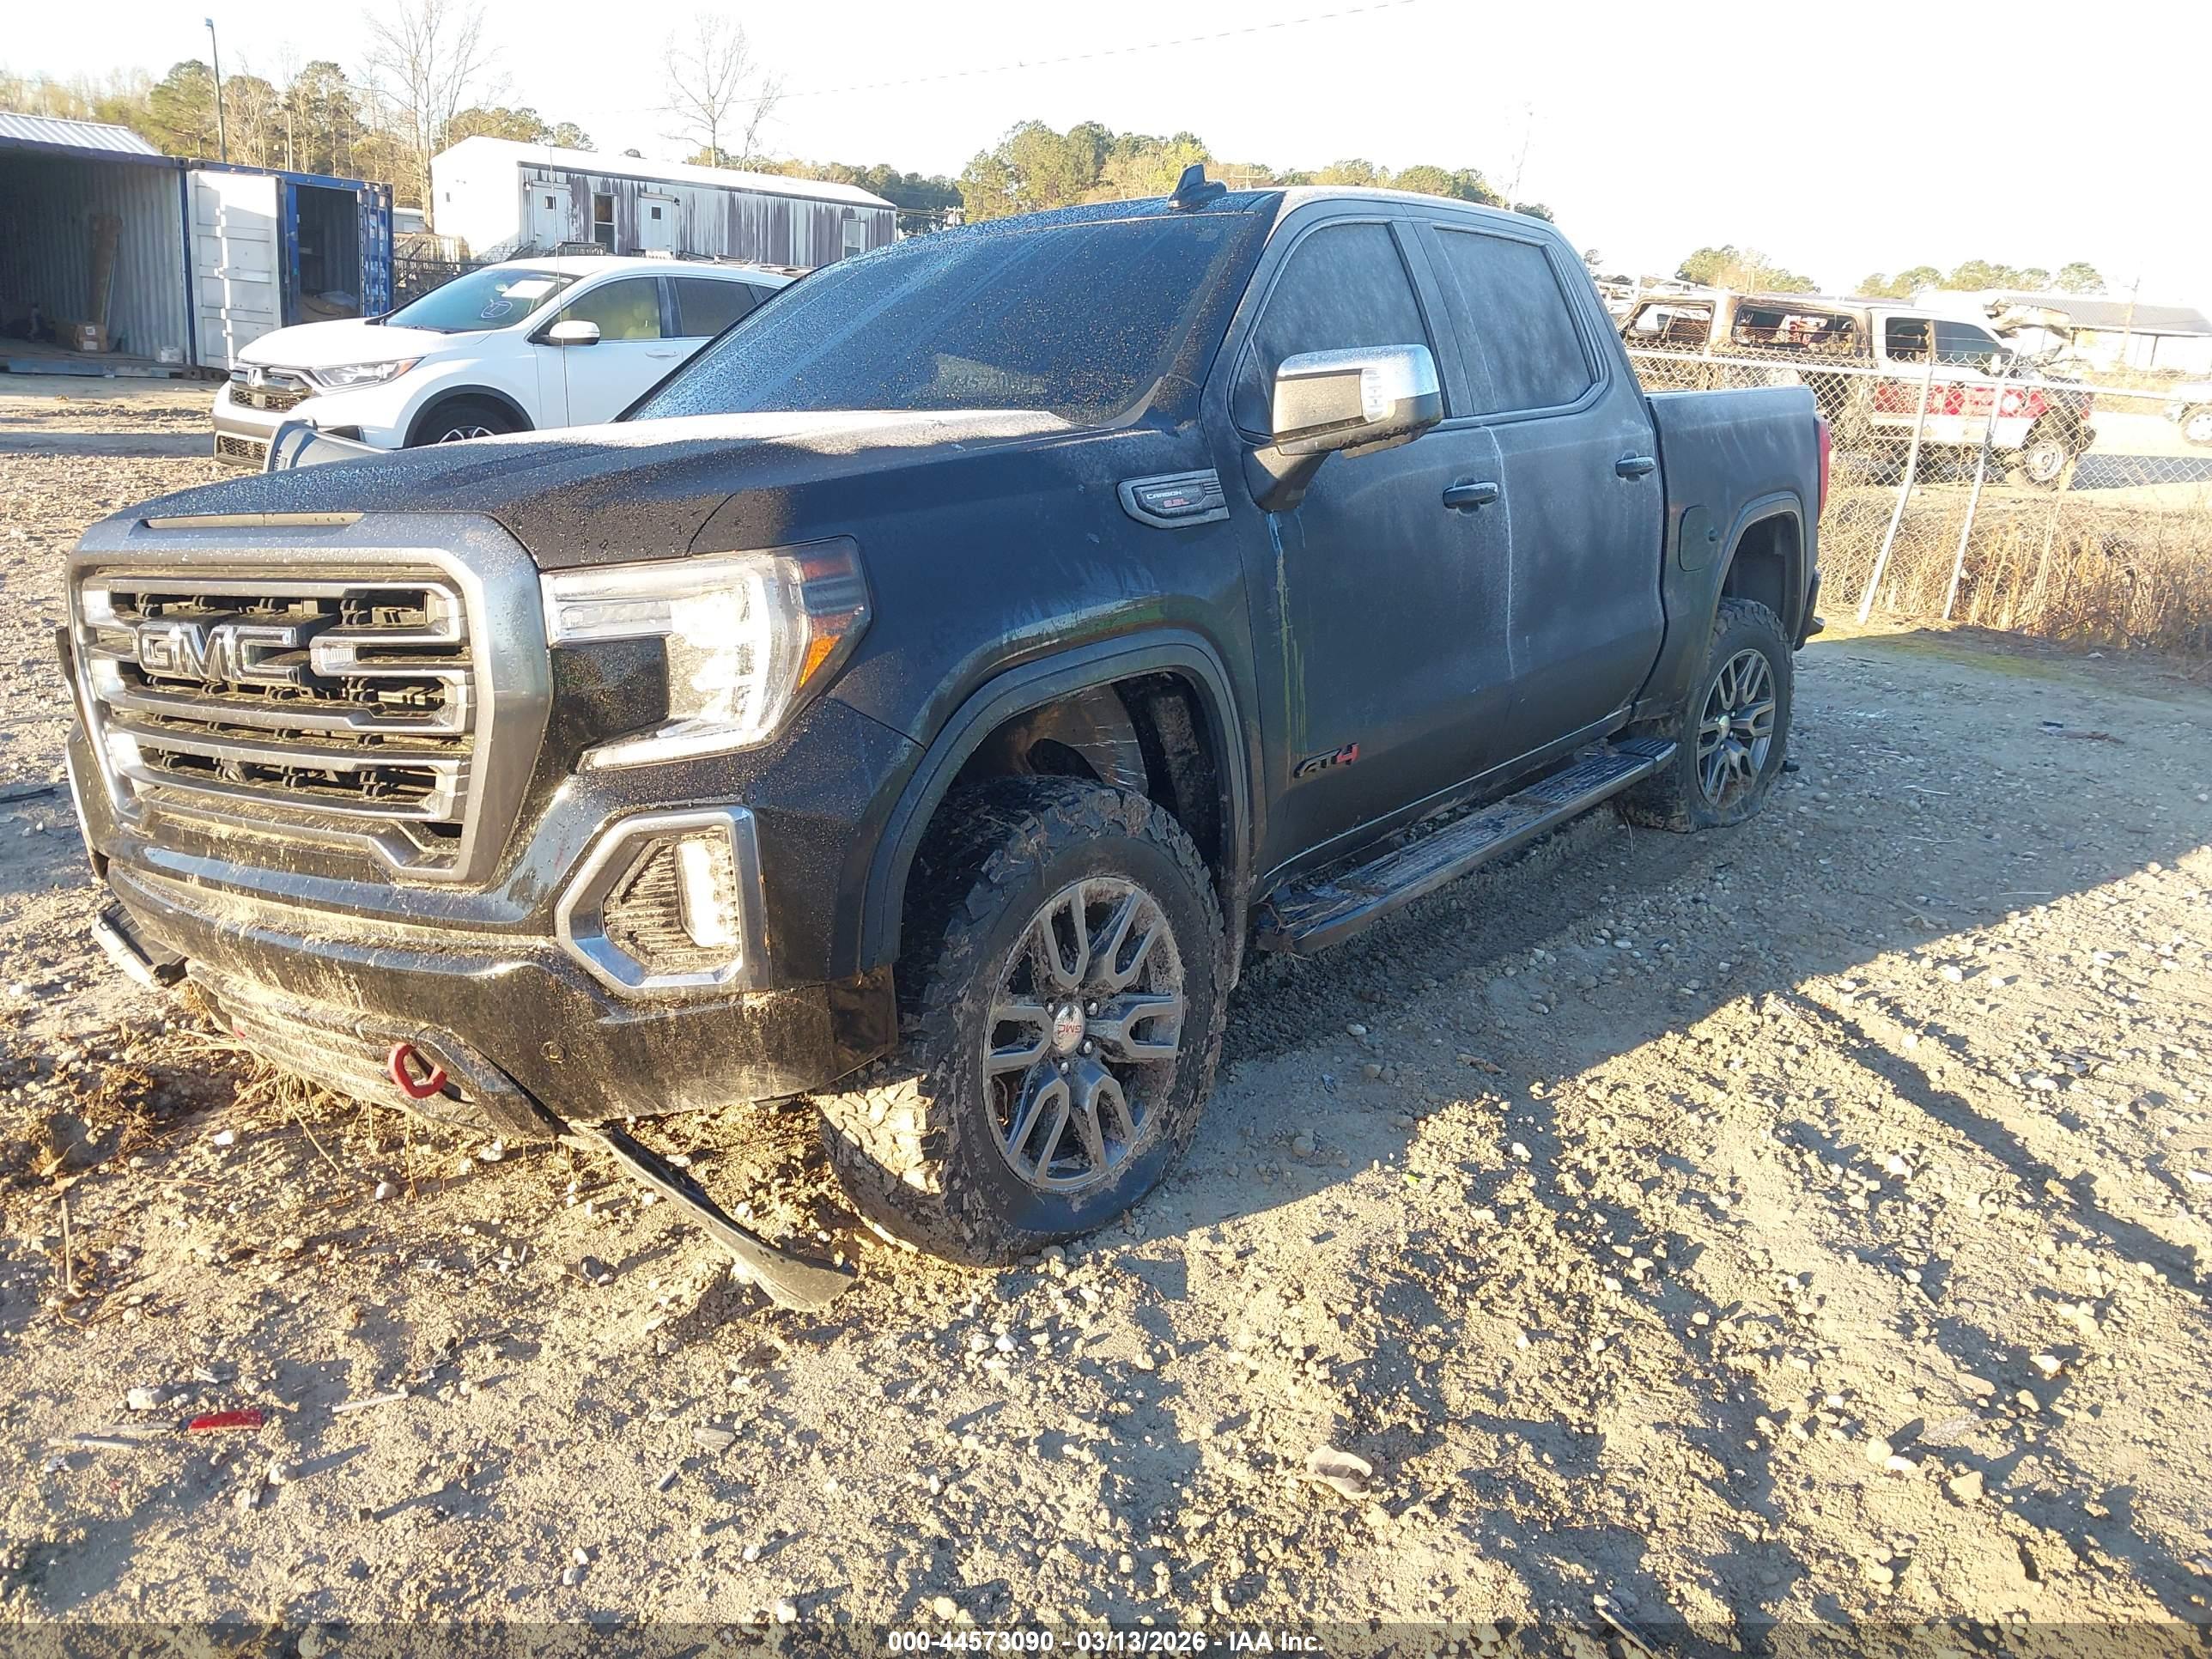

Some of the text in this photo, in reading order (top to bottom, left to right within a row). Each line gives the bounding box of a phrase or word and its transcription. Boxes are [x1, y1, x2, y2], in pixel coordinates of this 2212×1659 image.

[137, 622, 299, 686] GMC
[1294, 743, 1359, 779] AT4
[1057, 1024, 1081, 1035] GMC
